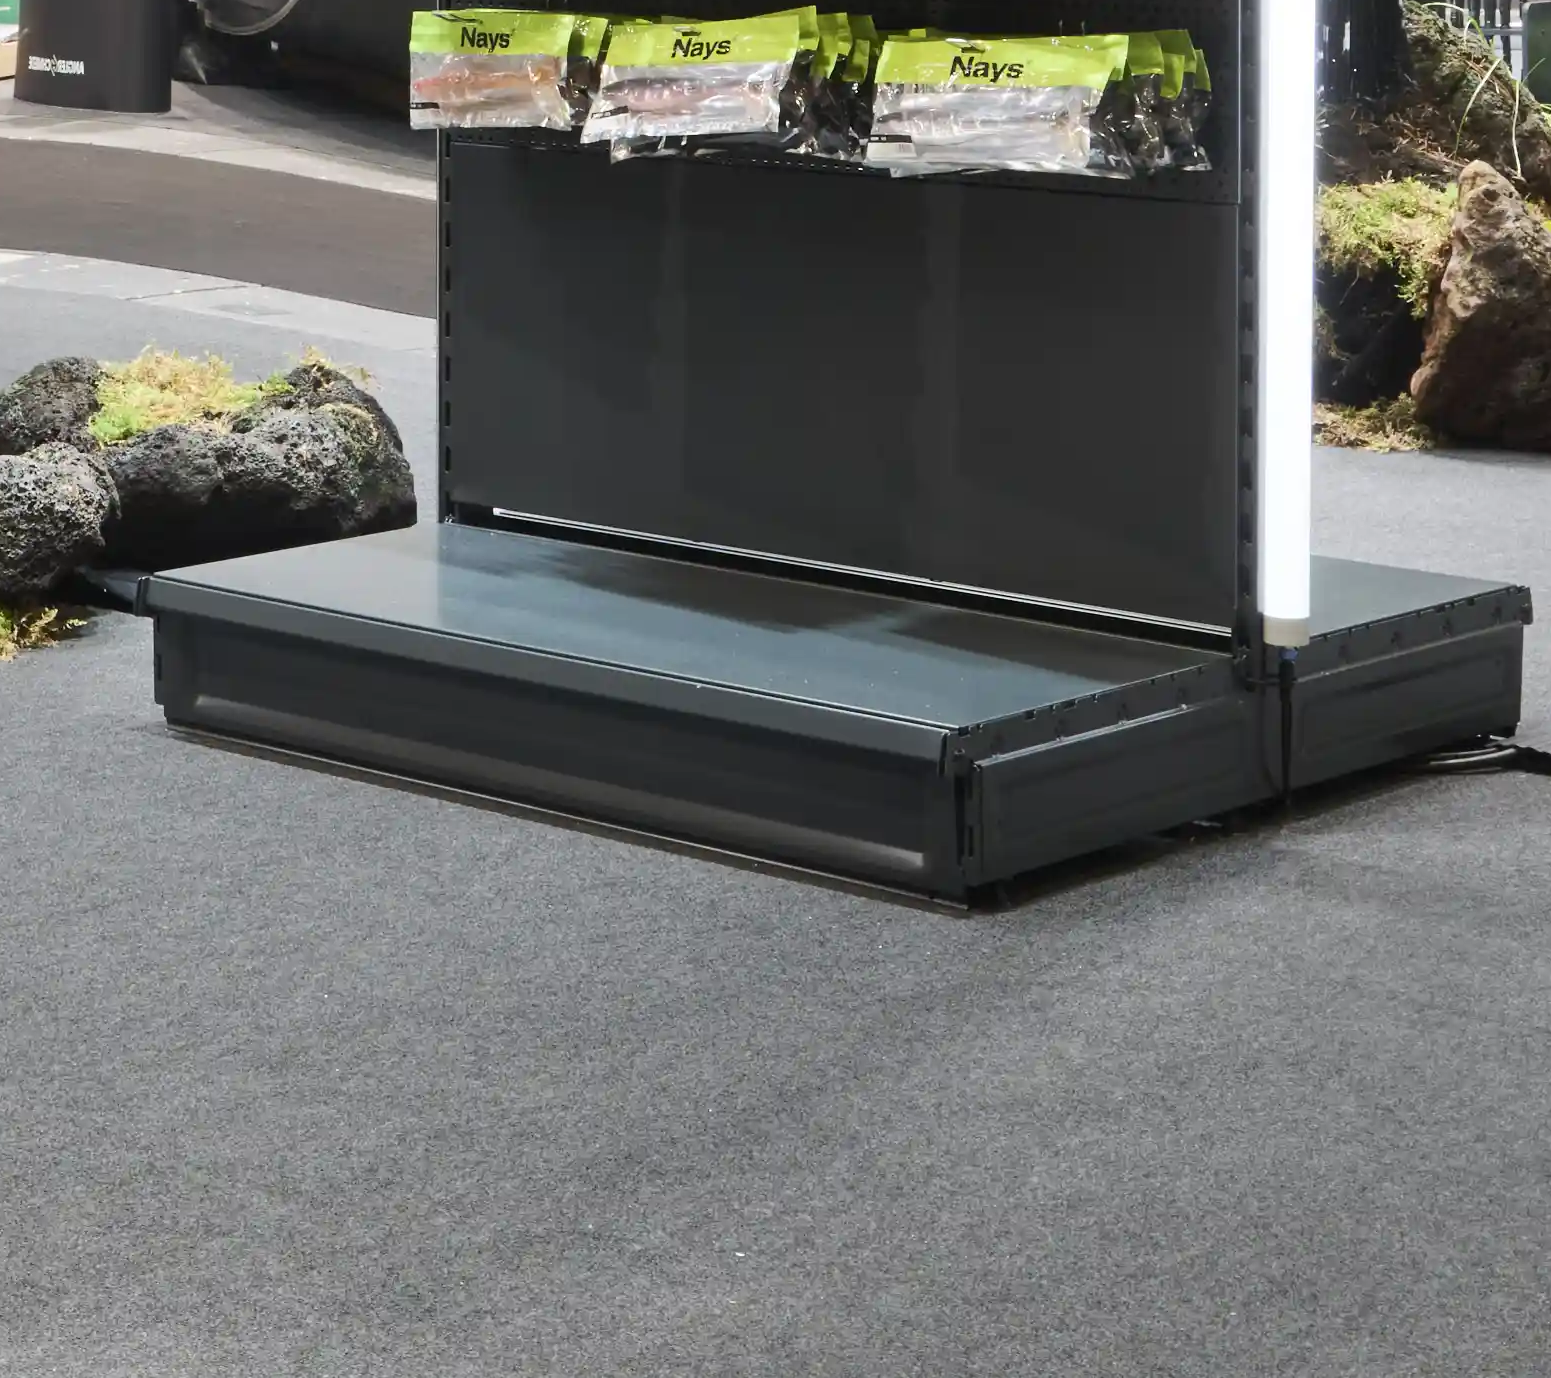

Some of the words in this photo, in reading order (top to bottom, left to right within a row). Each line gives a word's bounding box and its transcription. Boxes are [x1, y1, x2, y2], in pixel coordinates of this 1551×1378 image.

[460, 27, 511, 52] Nays
[672, 37, 731, 59] Nays
[950, 56, 1024, 82] Nays
